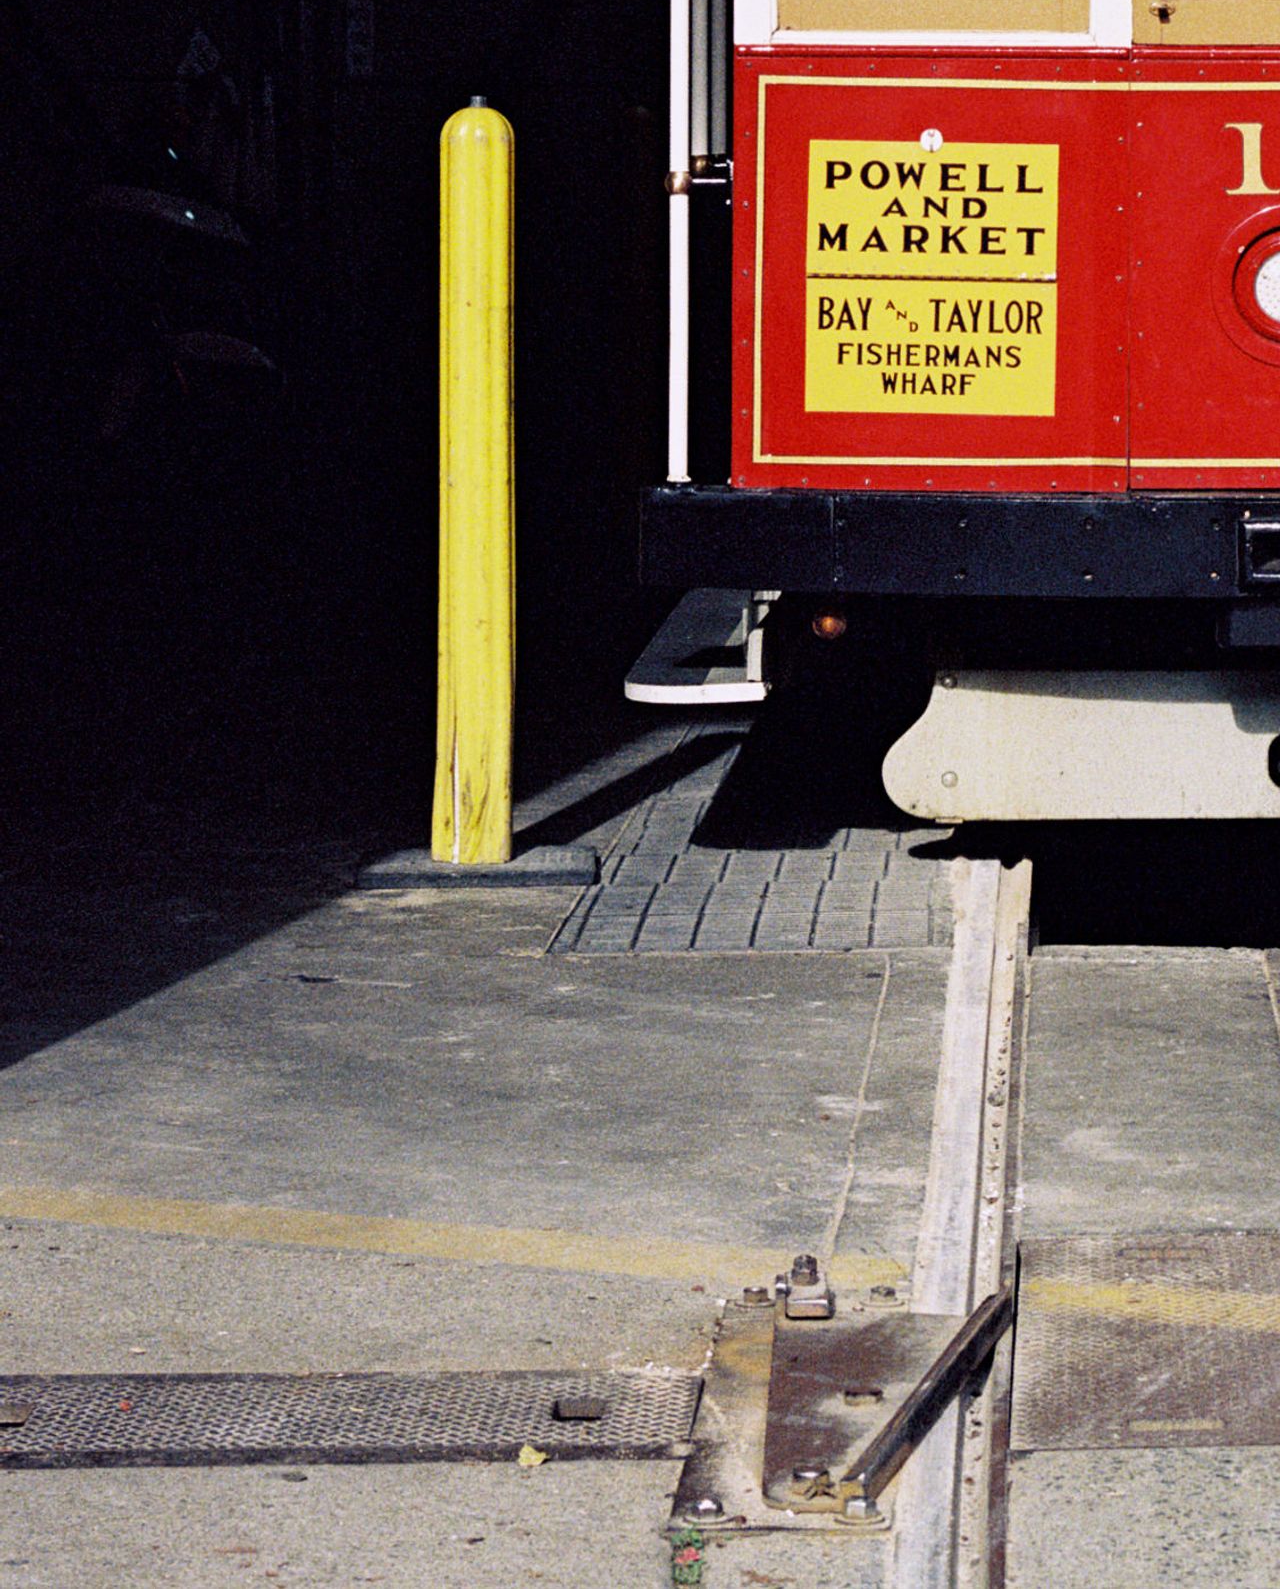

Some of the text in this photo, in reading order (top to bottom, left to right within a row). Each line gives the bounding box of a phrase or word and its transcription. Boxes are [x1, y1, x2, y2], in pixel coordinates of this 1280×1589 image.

[825, 160, 1043, 194] POWELL
[882, 196, 988, 219] AND
[818, 222, 1045, 255] MARKET
[818, 296, 1043, 334] BAY AND TAYLOR
[837, 342, 1021, 368] FISHERMANS
[881, 372, 976, 396] WHARF
